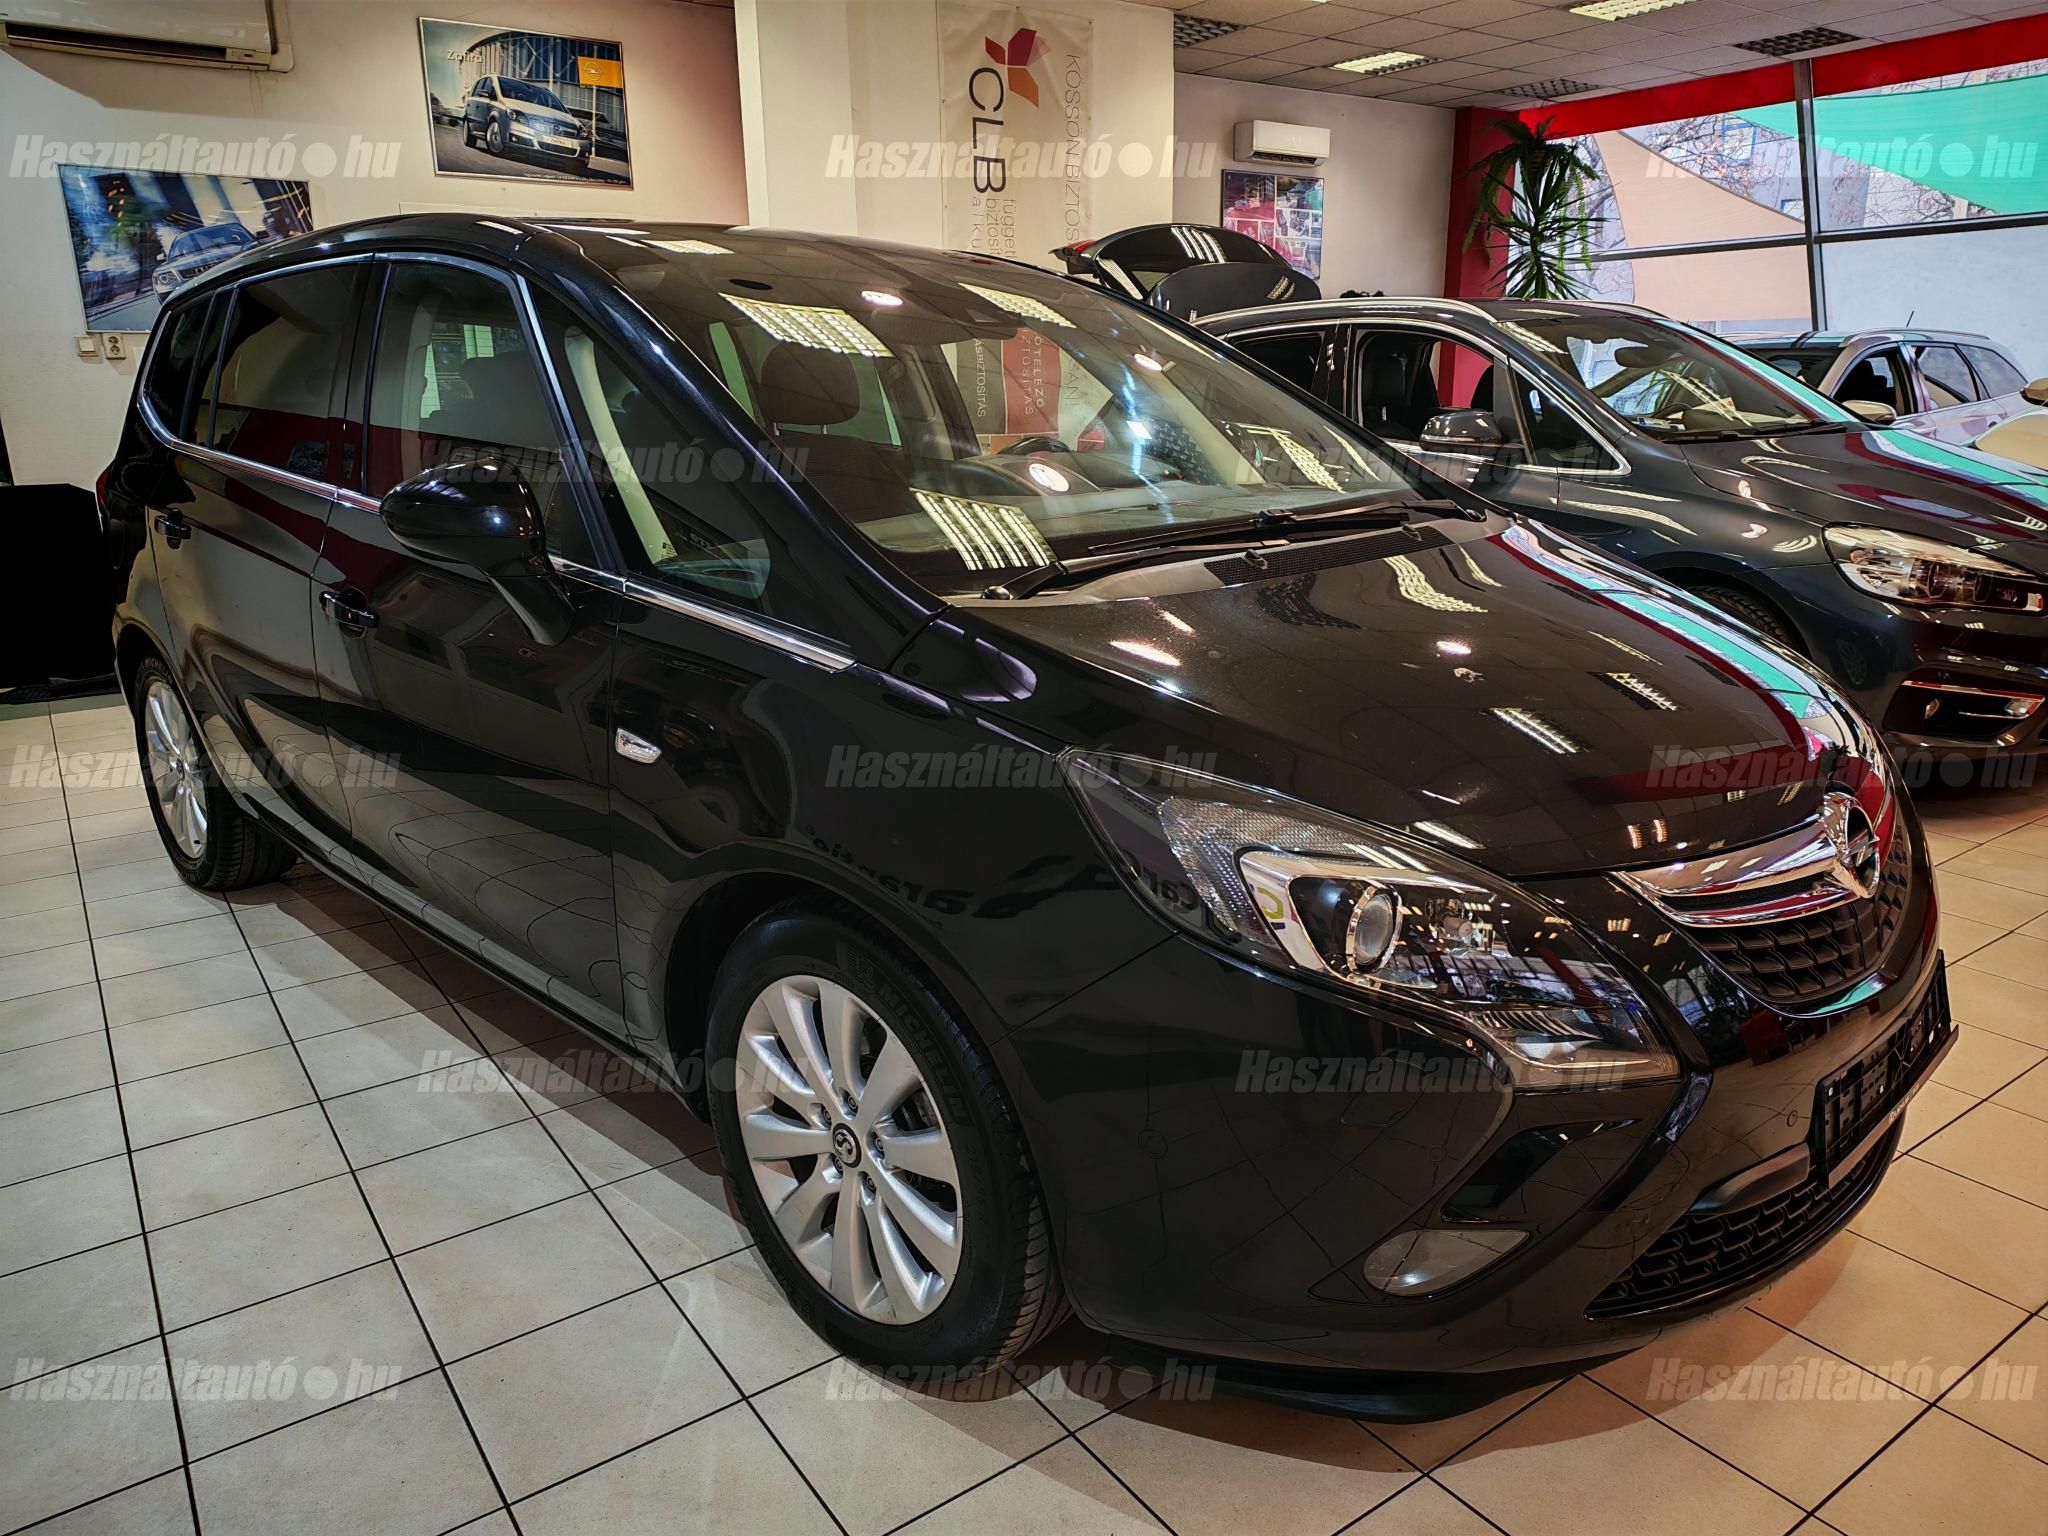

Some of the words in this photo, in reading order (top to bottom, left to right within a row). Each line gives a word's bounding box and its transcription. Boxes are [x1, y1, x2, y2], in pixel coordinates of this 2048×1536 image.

[447, 49, 484, 64] Zafira
[968, 67, 1007, 194] CLB
[1065, 54, 1084, 155] KÖSSÖN
[1064, 163, 1081, 244] BIZTOS
